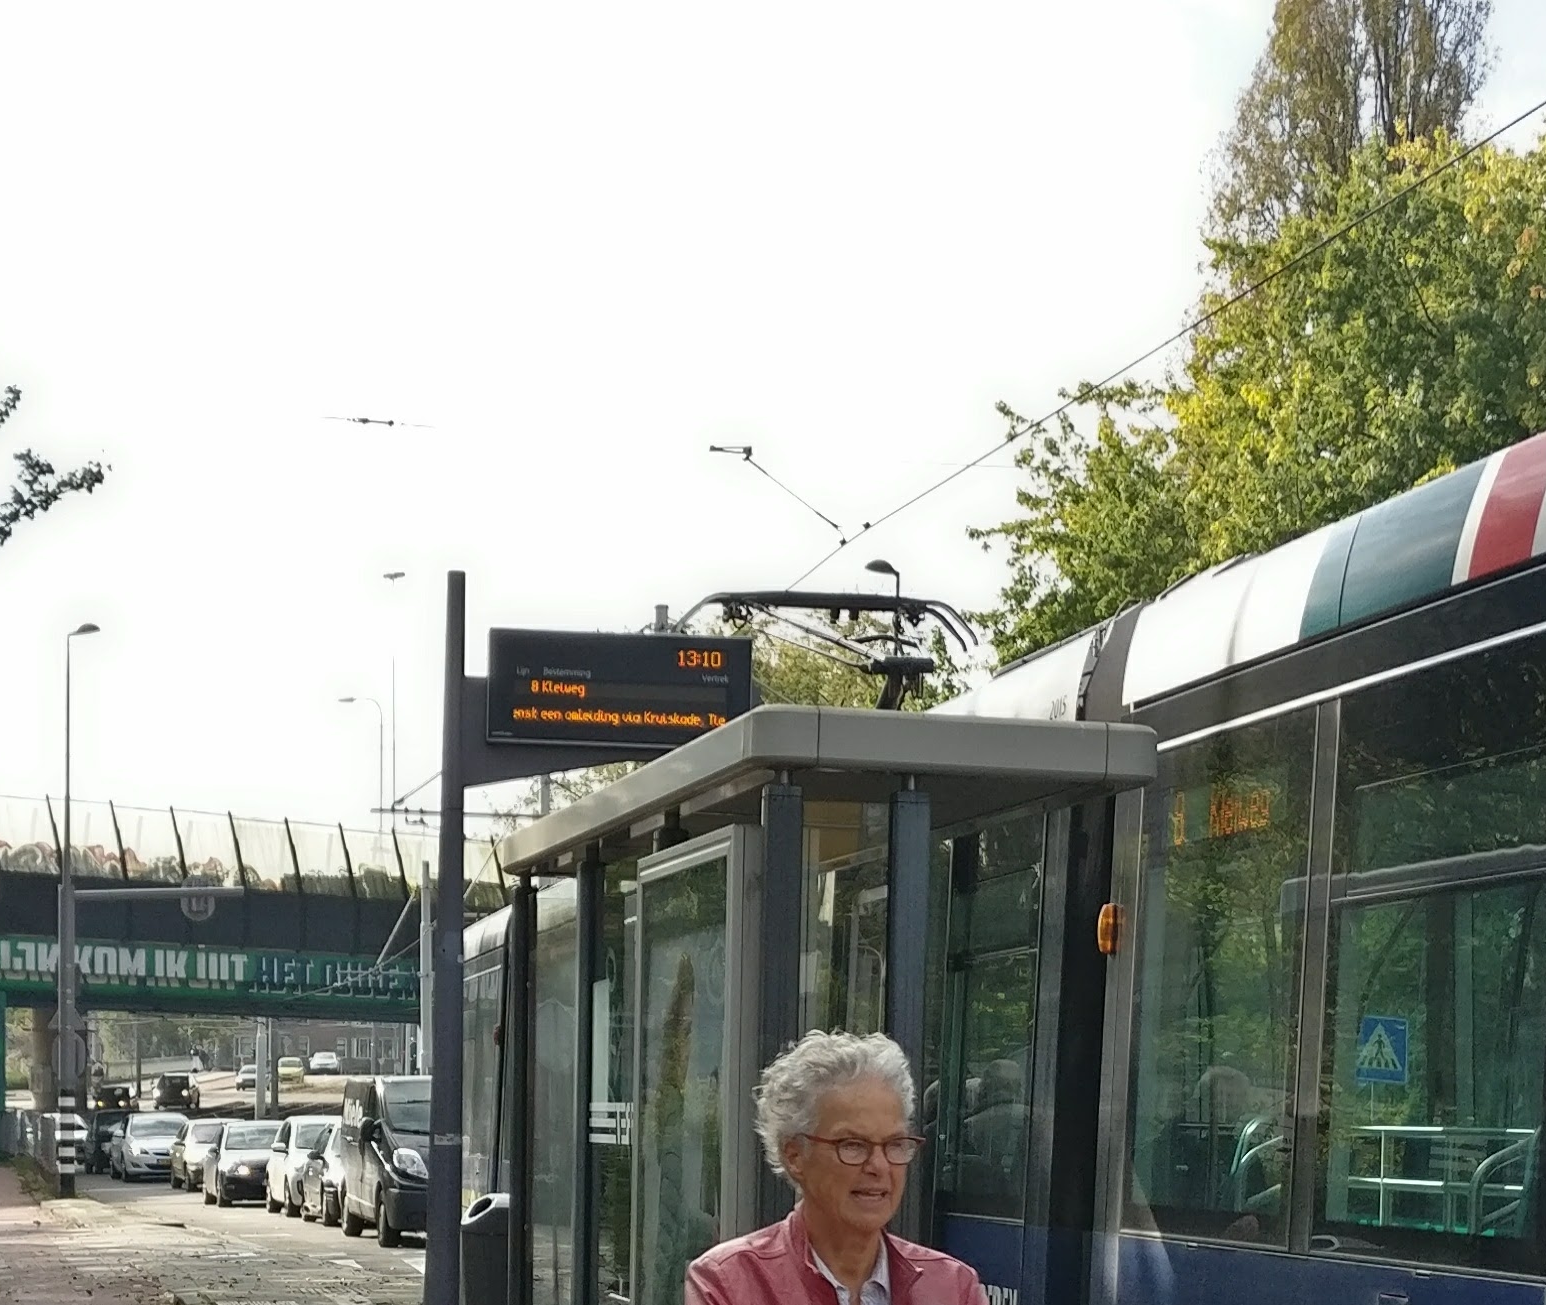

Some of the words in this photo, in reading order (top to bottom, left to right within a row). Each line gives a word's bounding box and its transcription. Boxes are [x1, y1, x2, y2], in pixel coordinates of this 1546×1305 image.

[677, 650, 722, 668] 13:10
[516, 666, 530, 675] Lijn
[543, 666, 592, 679] Bestemming
[702, 674, 729, 684] Vertrek
[530, 680, 539, 692] 8
[542, 680, 586, 699] Kleiweg
[540, 708, 562, 721] een
[565, 709, 619, 725] omleiding
[621, 712, 641, 724] via
[73, 942, 146, 977] KOM
[155, 946, 187, 980] IK
